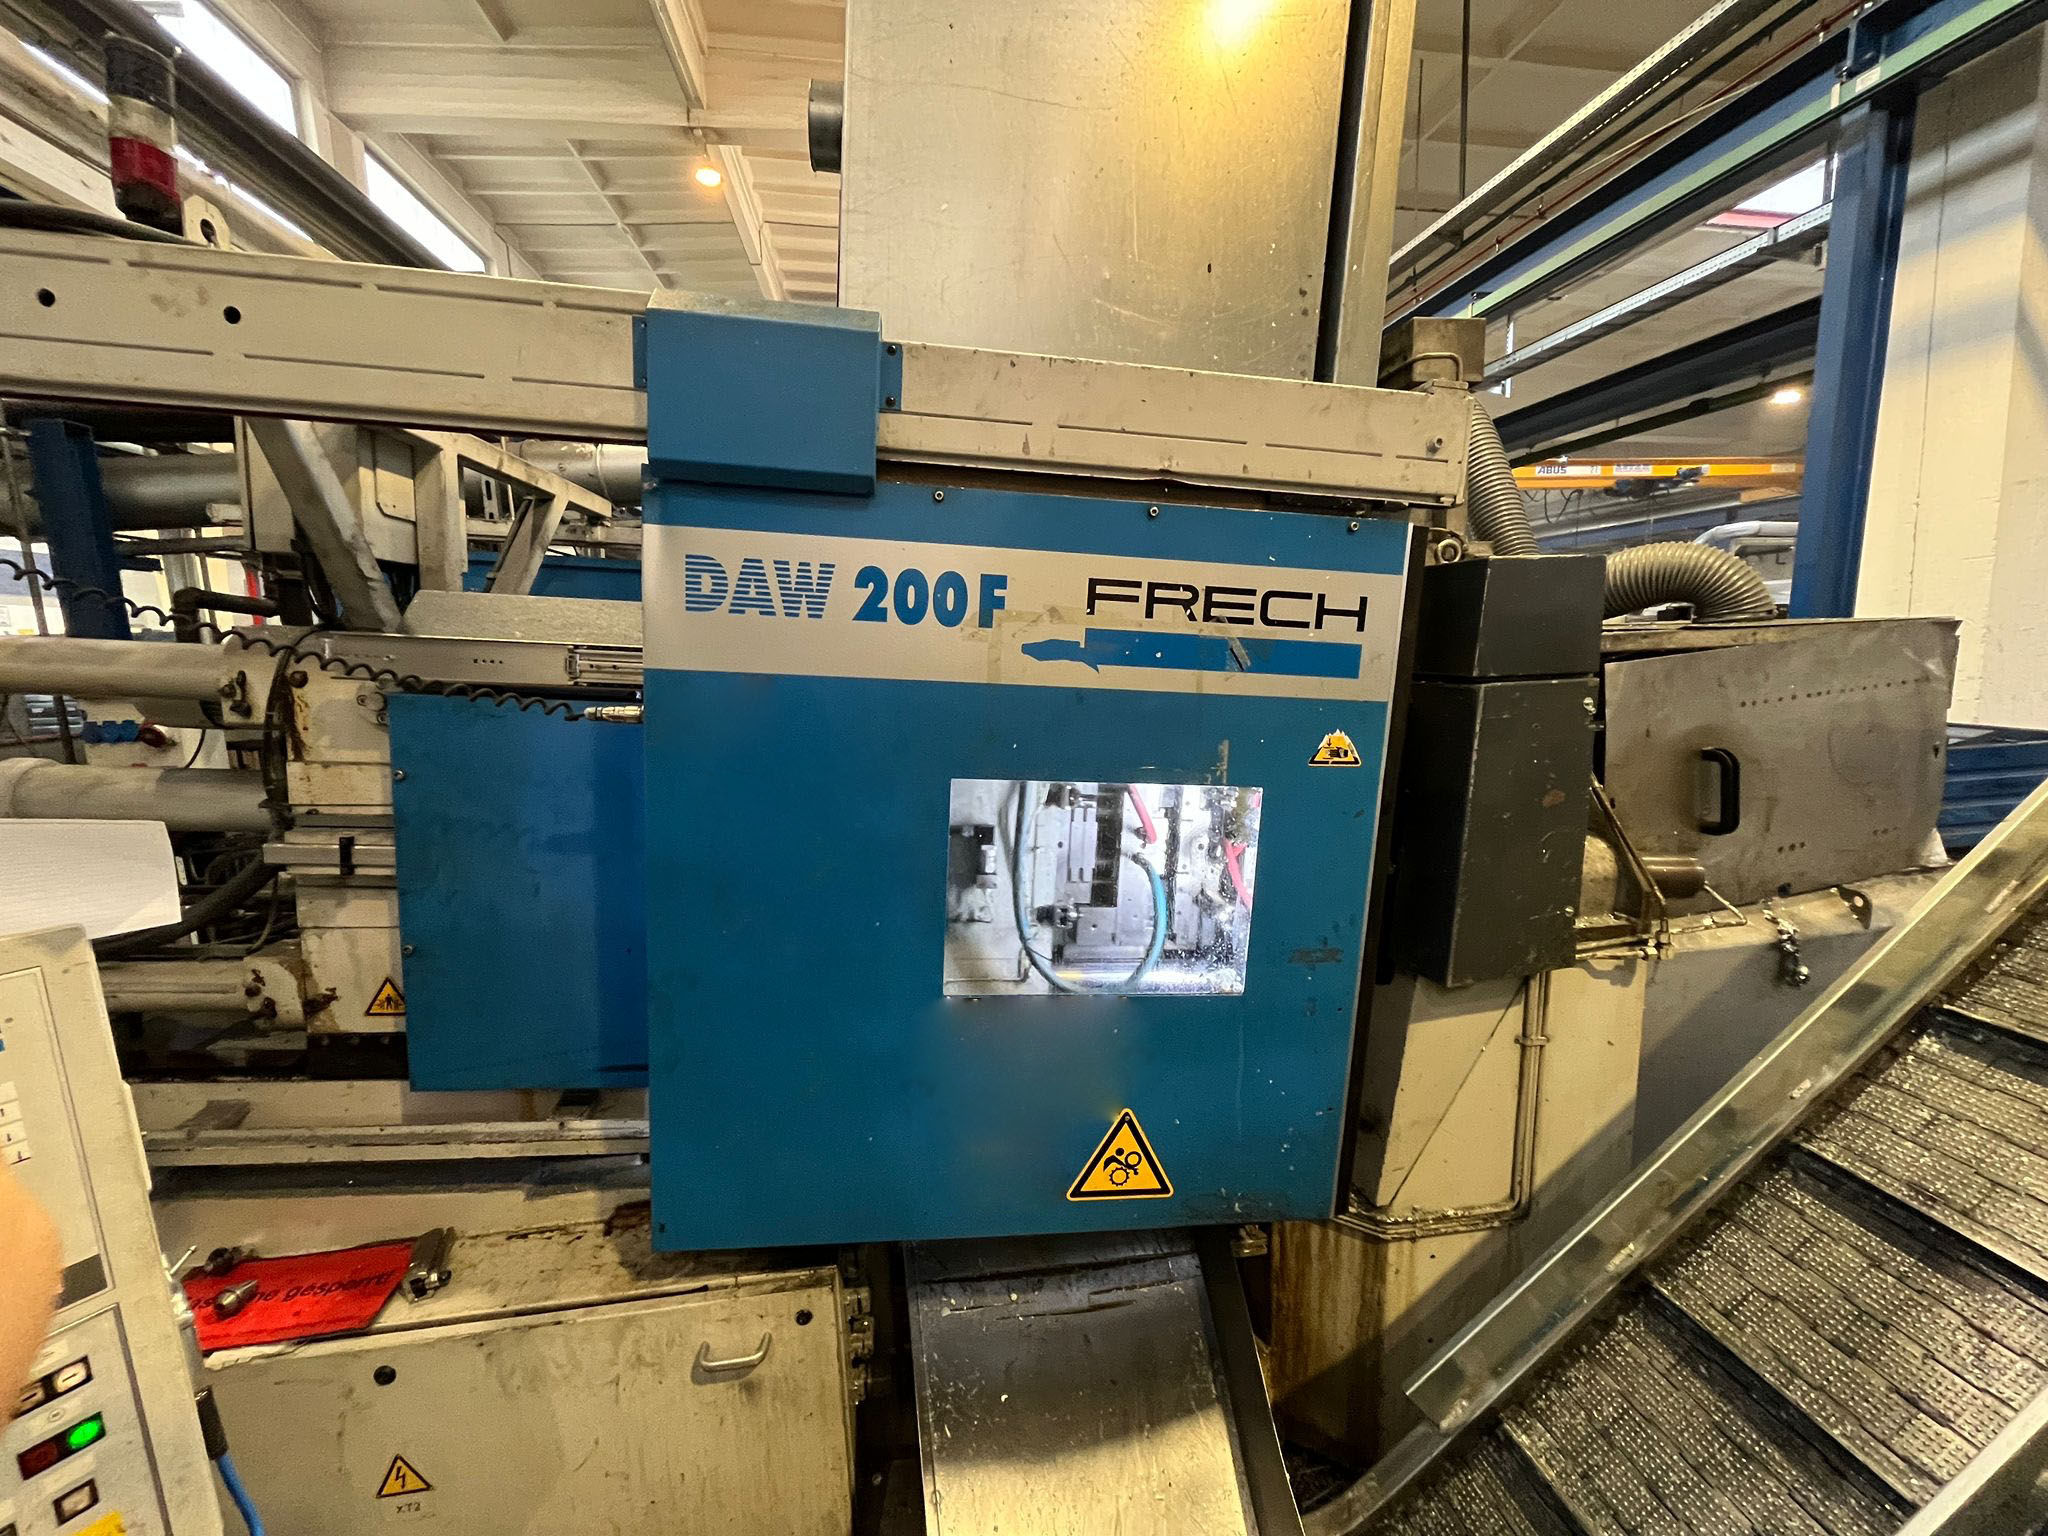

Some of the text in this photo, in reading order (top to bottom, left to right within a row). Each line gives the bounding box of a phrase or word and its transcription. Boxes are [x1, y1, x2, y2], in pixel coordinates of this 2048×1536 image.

[1537, 466, 1567, 474] ABUS
[685, 554, 836, 619] DAW
[1086, 577, 1368, 632] FRECH
